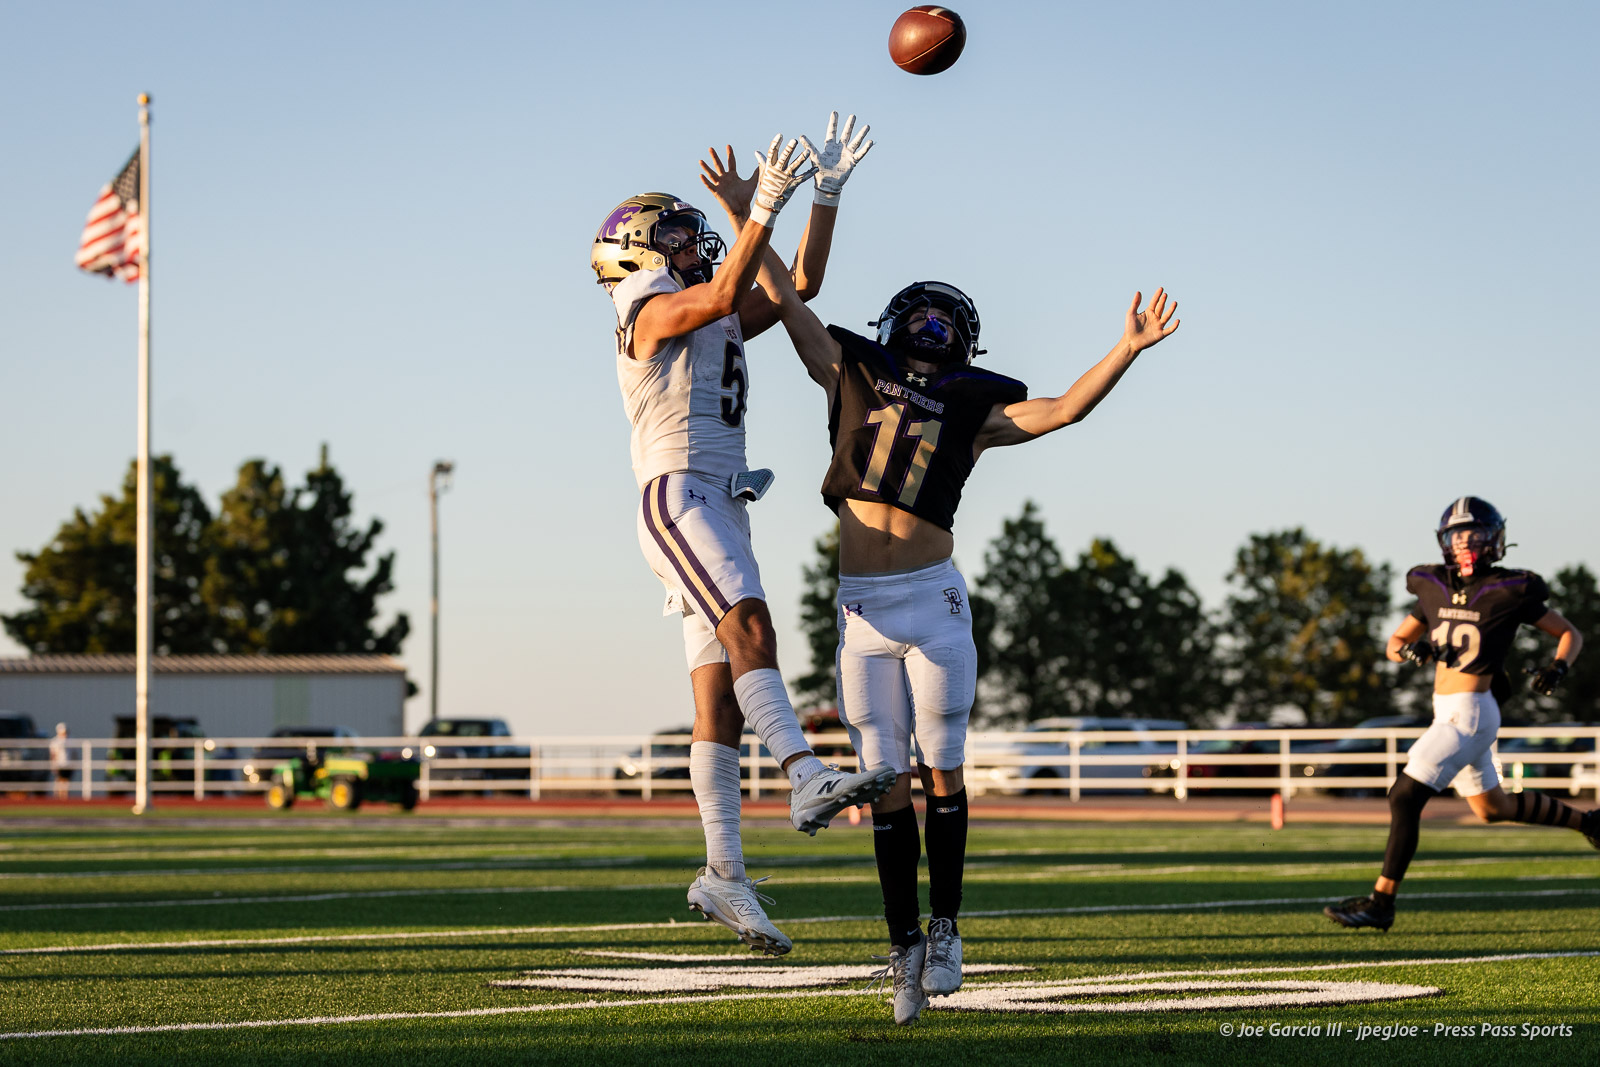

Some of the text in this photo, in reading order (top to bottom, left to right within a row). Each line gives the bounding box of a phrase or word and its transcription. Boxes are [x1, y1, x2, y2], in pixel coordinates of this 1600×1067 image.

[720, 338, 746, 428] 5
[874, 378, 945, 415] PANTHERS
[858, 400, 945, 510] 11
[1431, 620, 1481, 673] 12
